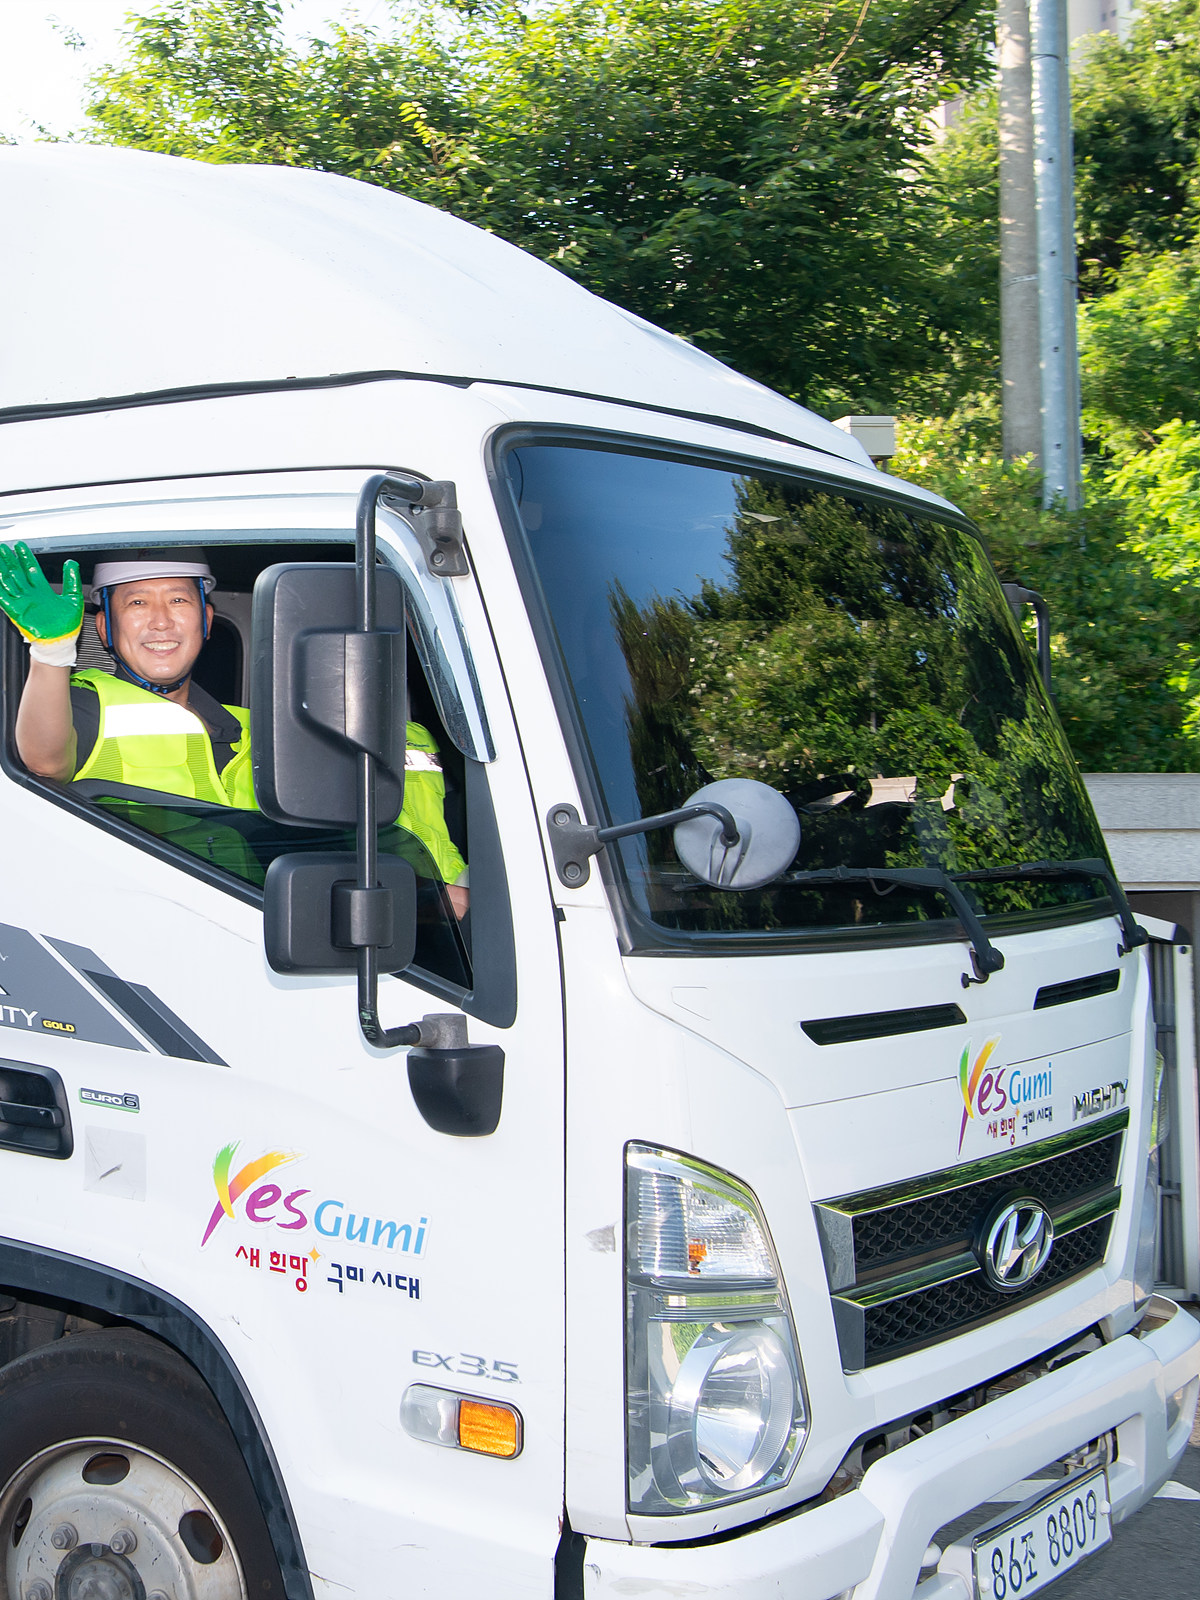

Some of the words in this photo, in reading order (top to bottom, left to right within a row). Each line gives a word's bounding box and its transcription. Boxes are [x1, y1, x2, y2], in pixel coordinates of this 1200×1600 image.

[42, 1018, 76, 1034] GOLD
[1071, 1078, 1129, 1122] MIGHTY
[235, 1245, 260, 1269] 새
[269, 1249, 309, 1293] 희망
[991, 1530, 1038, 1600] 86조
[1047, 1489, 1097, 1568] 8809
